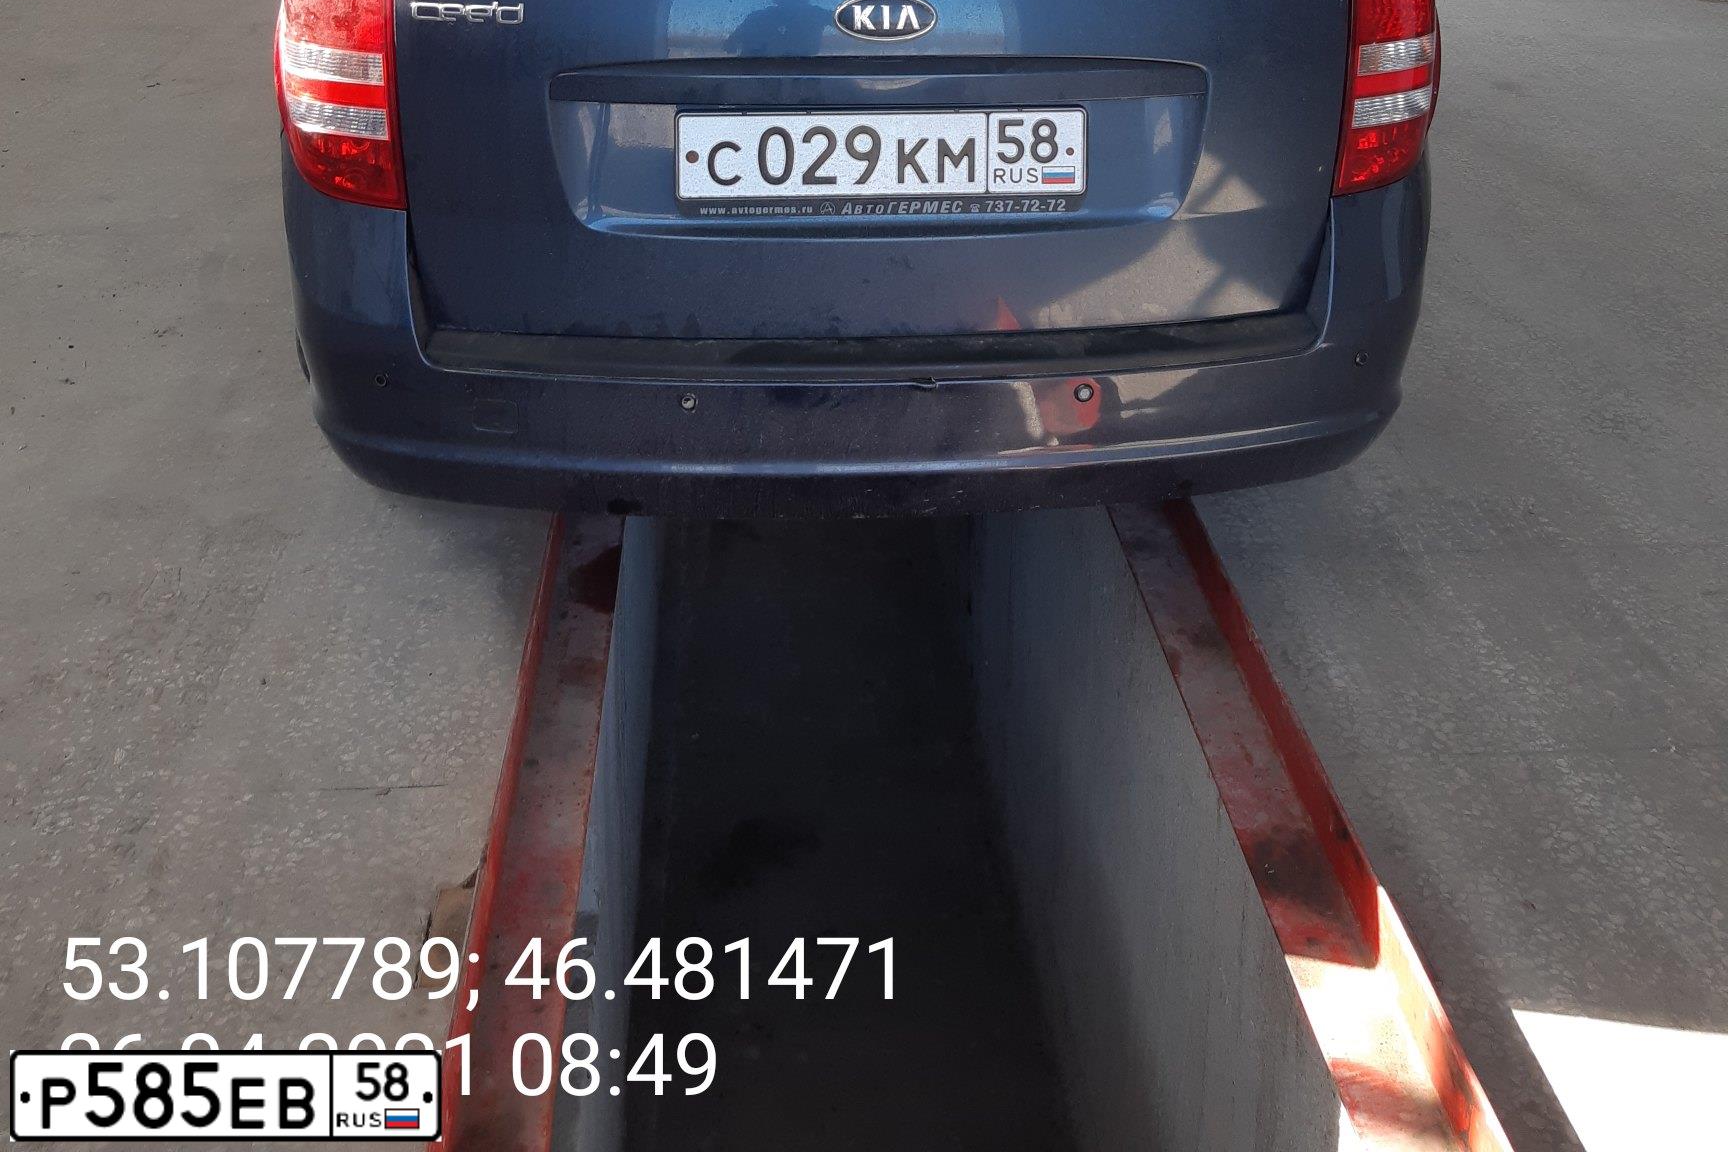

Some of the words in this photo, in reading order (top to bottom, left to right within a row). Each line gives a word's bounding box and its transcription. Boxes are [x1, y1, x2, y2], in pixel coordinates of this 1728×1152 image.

[851, 3, 922, 32] KIA
[996, 119, 1059, 164] 58
[993, 167, 1039, 184] RUS
[985, 198, 1066, 213] 737-72-72
